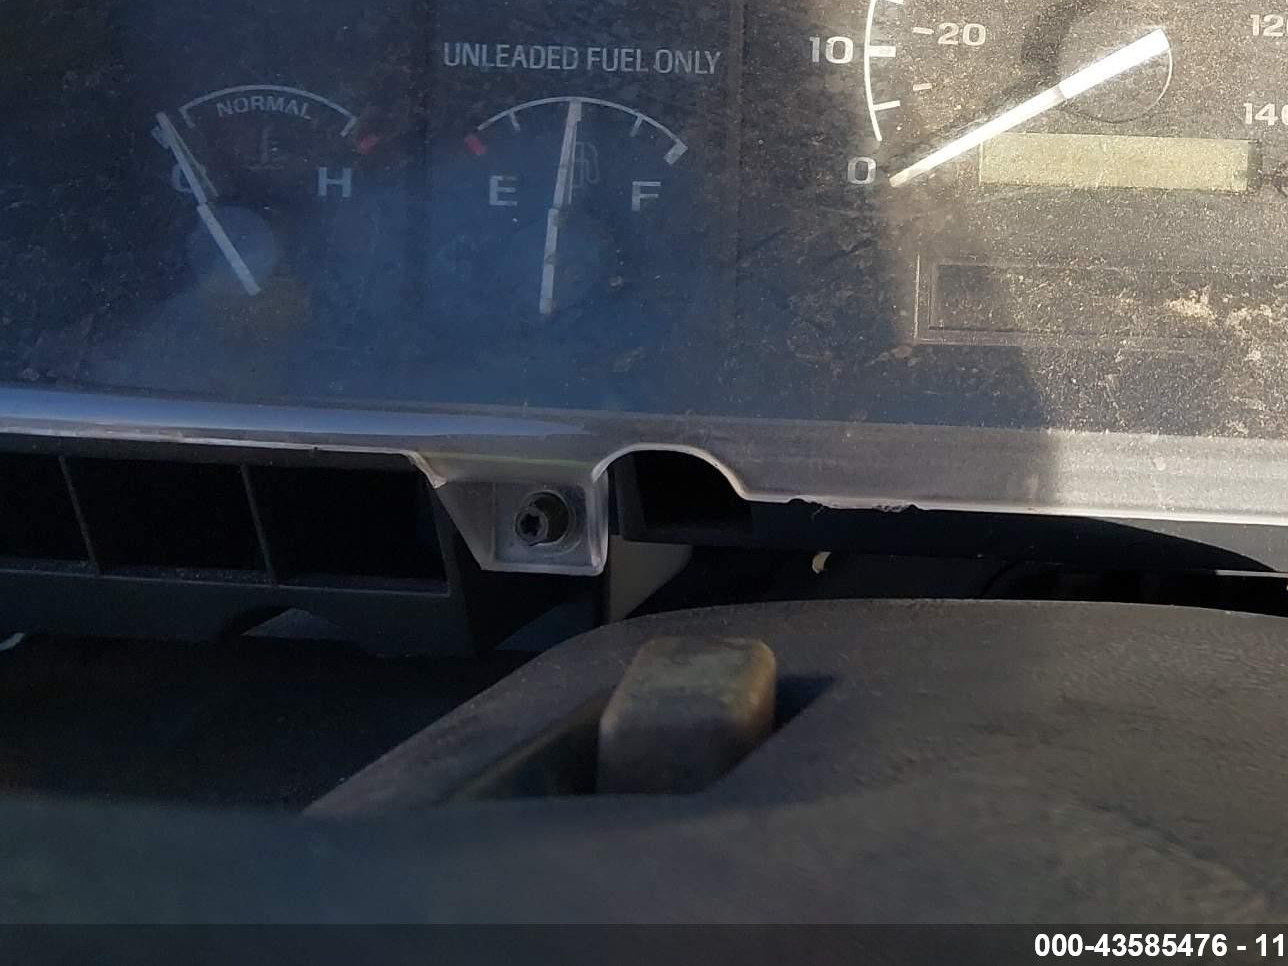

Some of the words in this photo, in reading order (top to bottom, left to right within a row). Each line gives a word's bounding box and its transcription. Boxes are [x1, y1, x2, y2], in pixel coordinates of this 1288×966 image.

[938, 23, 987, 47] 20
[443, 42, 579, 70] UNLEADED
[587, 46, 650, 73] FUEL
[653, 49, 722, 75] ONLY
[810, 37, 854, 65] 10
[216, 96, 312, 120] NORMAL
[318, 167, 352, 198] H
[848, 157, 876, 185] 0
[489, 176, 518, 207] E
[632, 181, 662, 212] F
